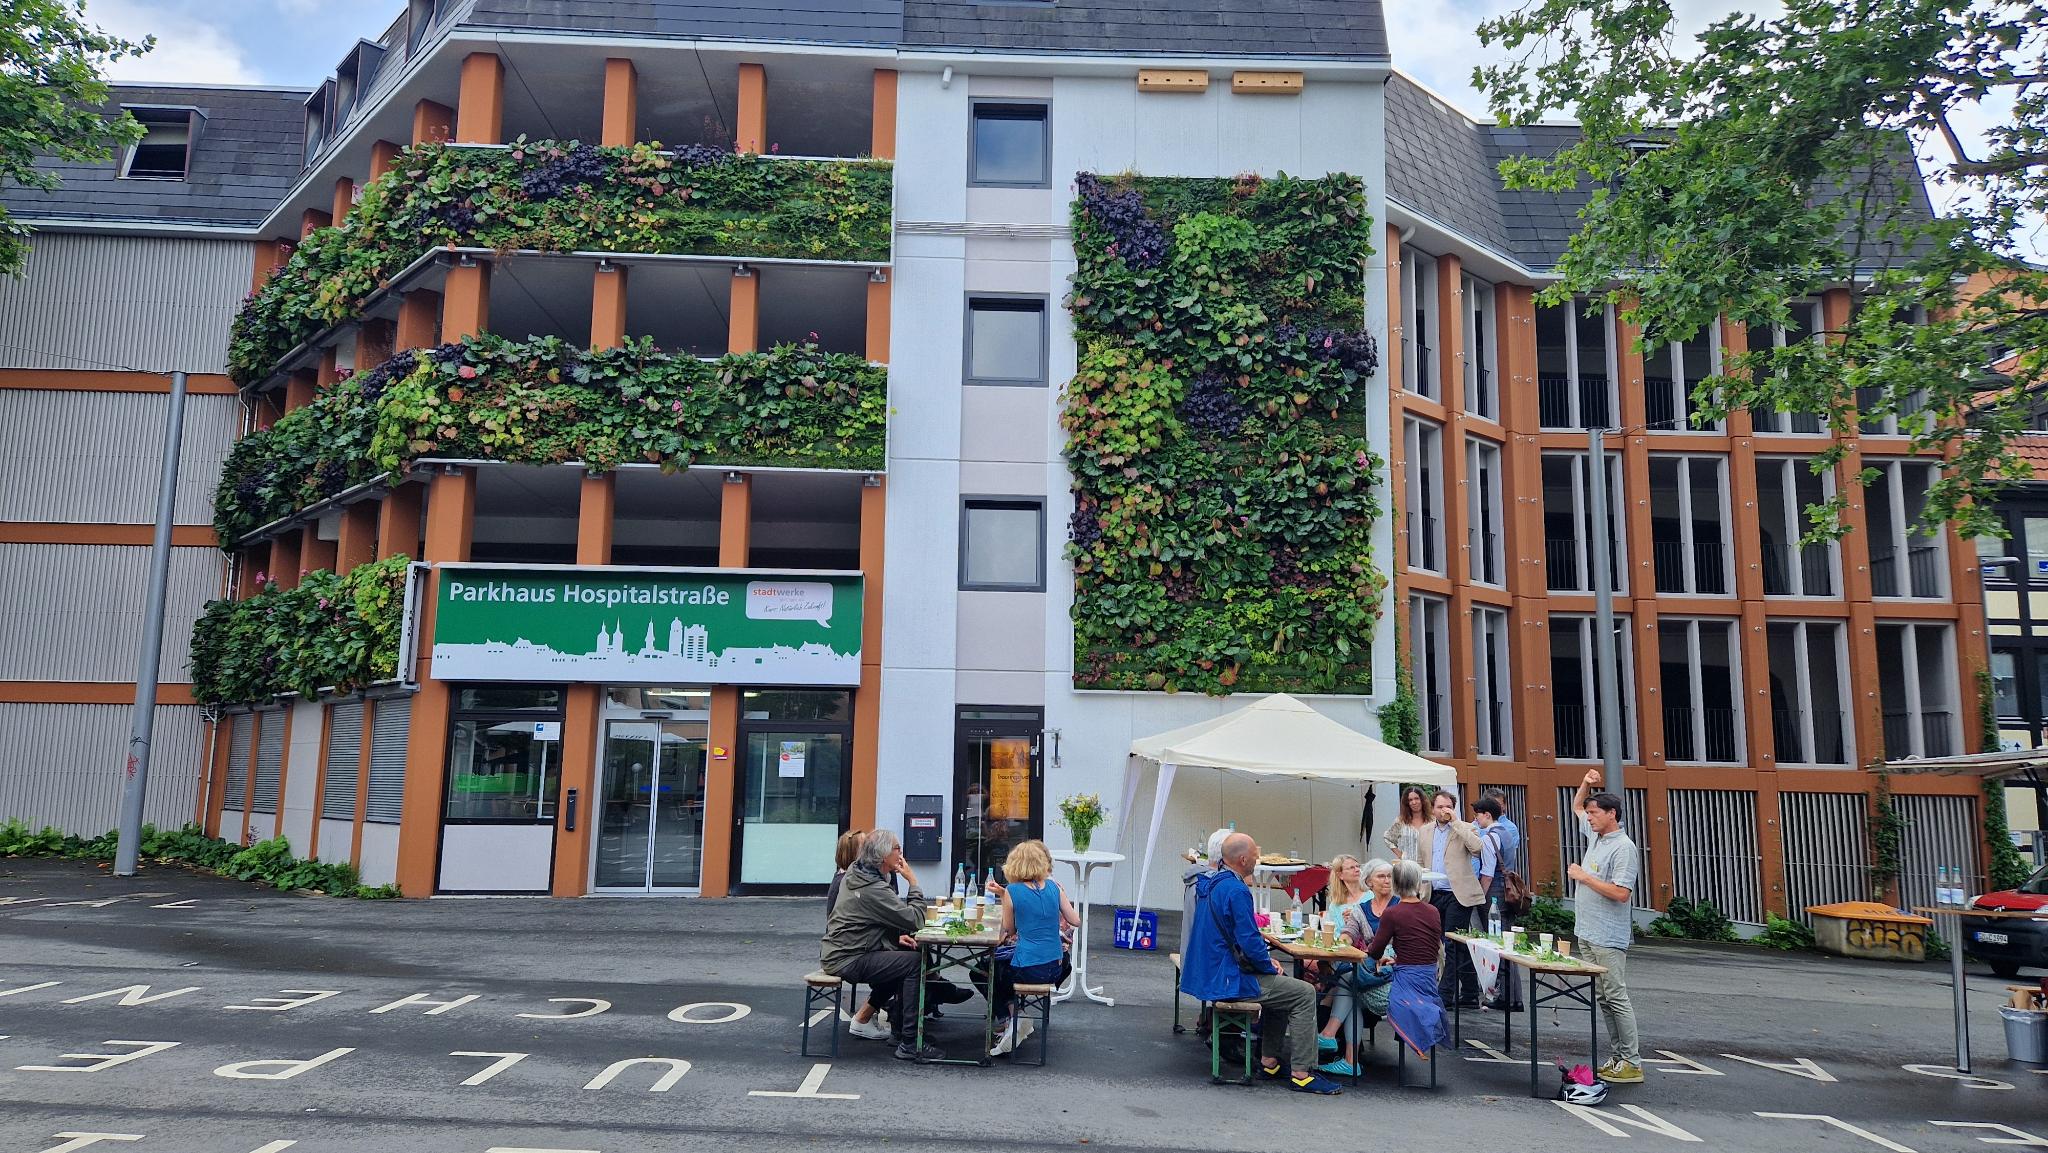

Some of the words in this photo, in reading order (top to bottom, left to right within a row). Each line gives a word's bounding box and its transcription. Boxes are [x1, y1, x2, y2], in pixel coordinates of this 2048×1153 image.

[450, 582, 556, 603] Parkhaus
[564, 584, 730, 608] Hospitalstraße
[753, 587, 805, 597] stadtwerke
[0, 1036, 861, 1100] TULPE
[1464, 1039, 2048, 1089] SAFT
